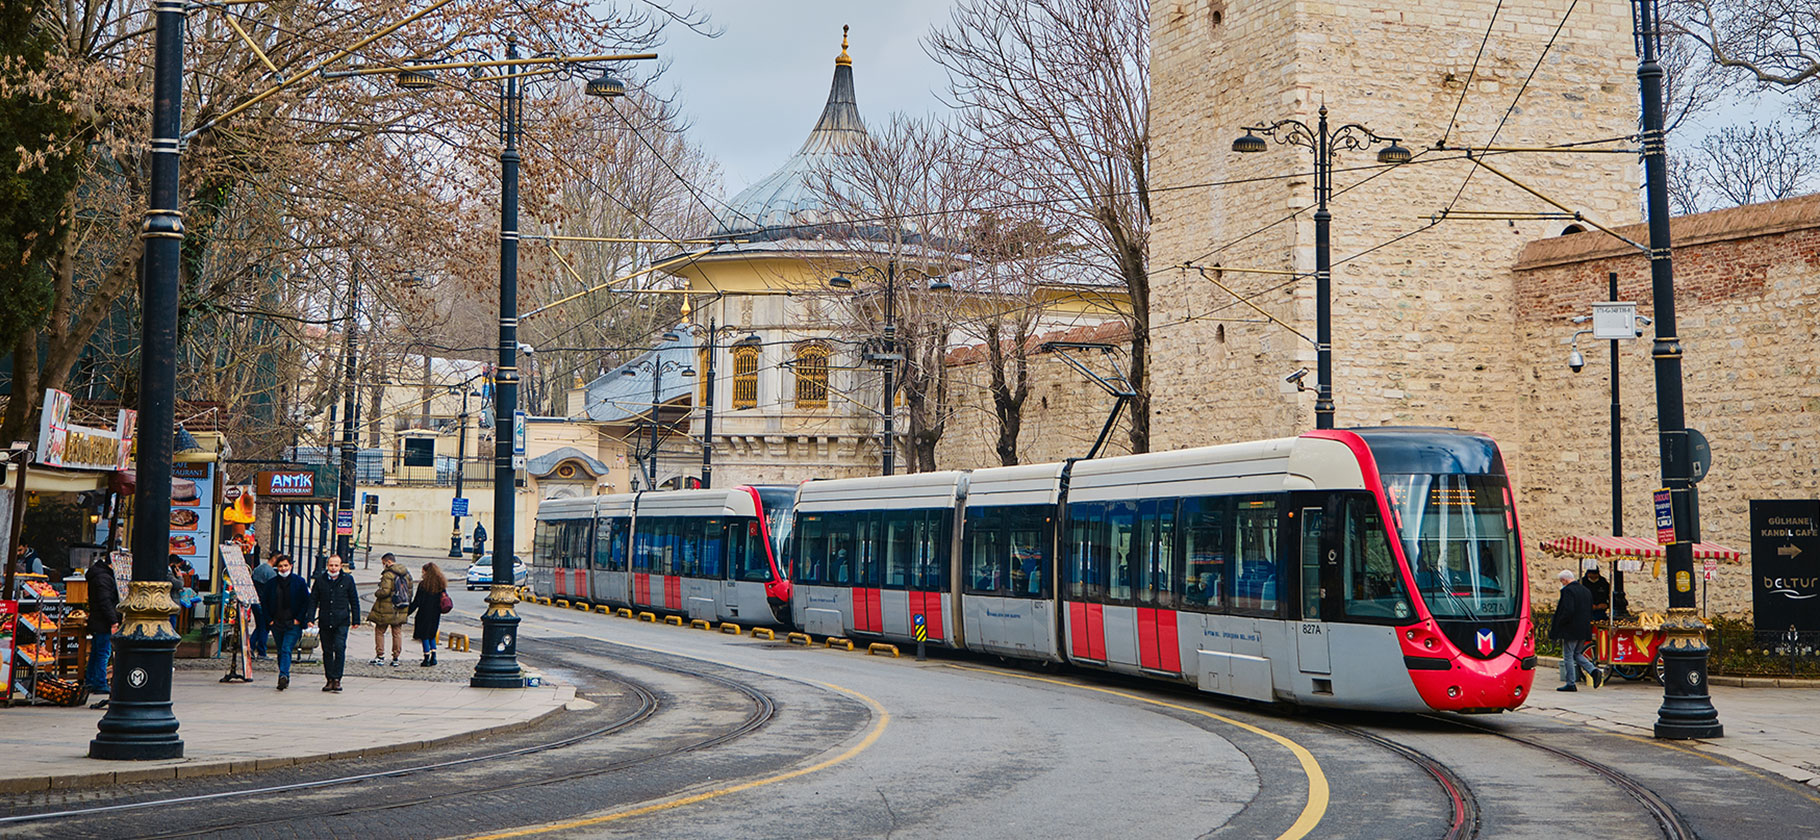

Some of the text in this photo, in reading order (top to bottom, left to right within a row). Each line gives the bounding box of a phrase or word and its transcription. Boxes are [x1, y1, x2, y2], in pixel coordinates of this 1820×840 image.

[1768, 517, 1809, 526] GÜLHANE
[1761, 528, 1794, 537] KANDİL
[1481, 603, 1506, 613] 827A
[1302, 624, 1321, 635] 827A
